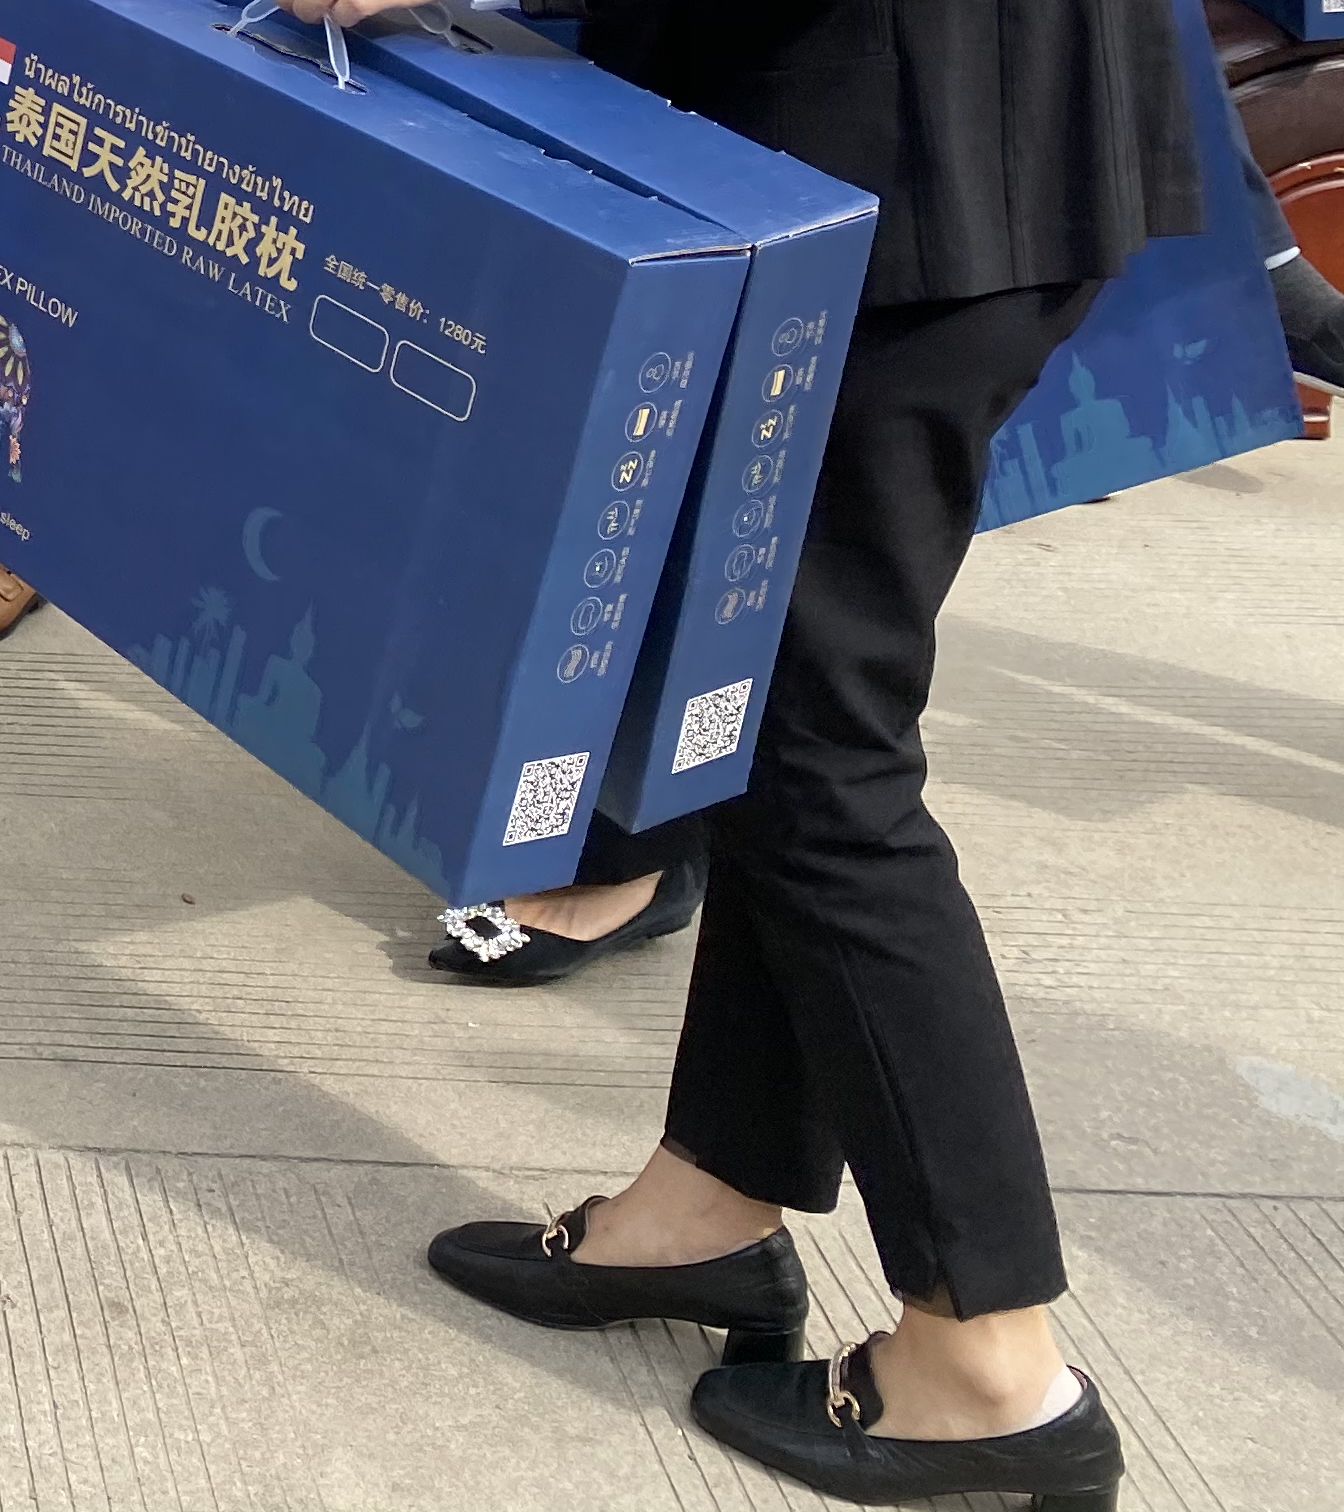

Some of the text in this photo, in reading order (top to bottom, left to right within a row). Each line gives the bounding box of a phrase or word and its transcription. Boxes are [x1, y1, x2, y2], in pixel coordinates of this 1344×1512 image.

[2, 144, 292, 323] THAILAND IMPORTED RAW LATEX
[5, 85, 306, 292] 泰国天然乳胶枕
[15, 277, 79, 328] PILLOW
[0, 509, 31, 542] sleep
